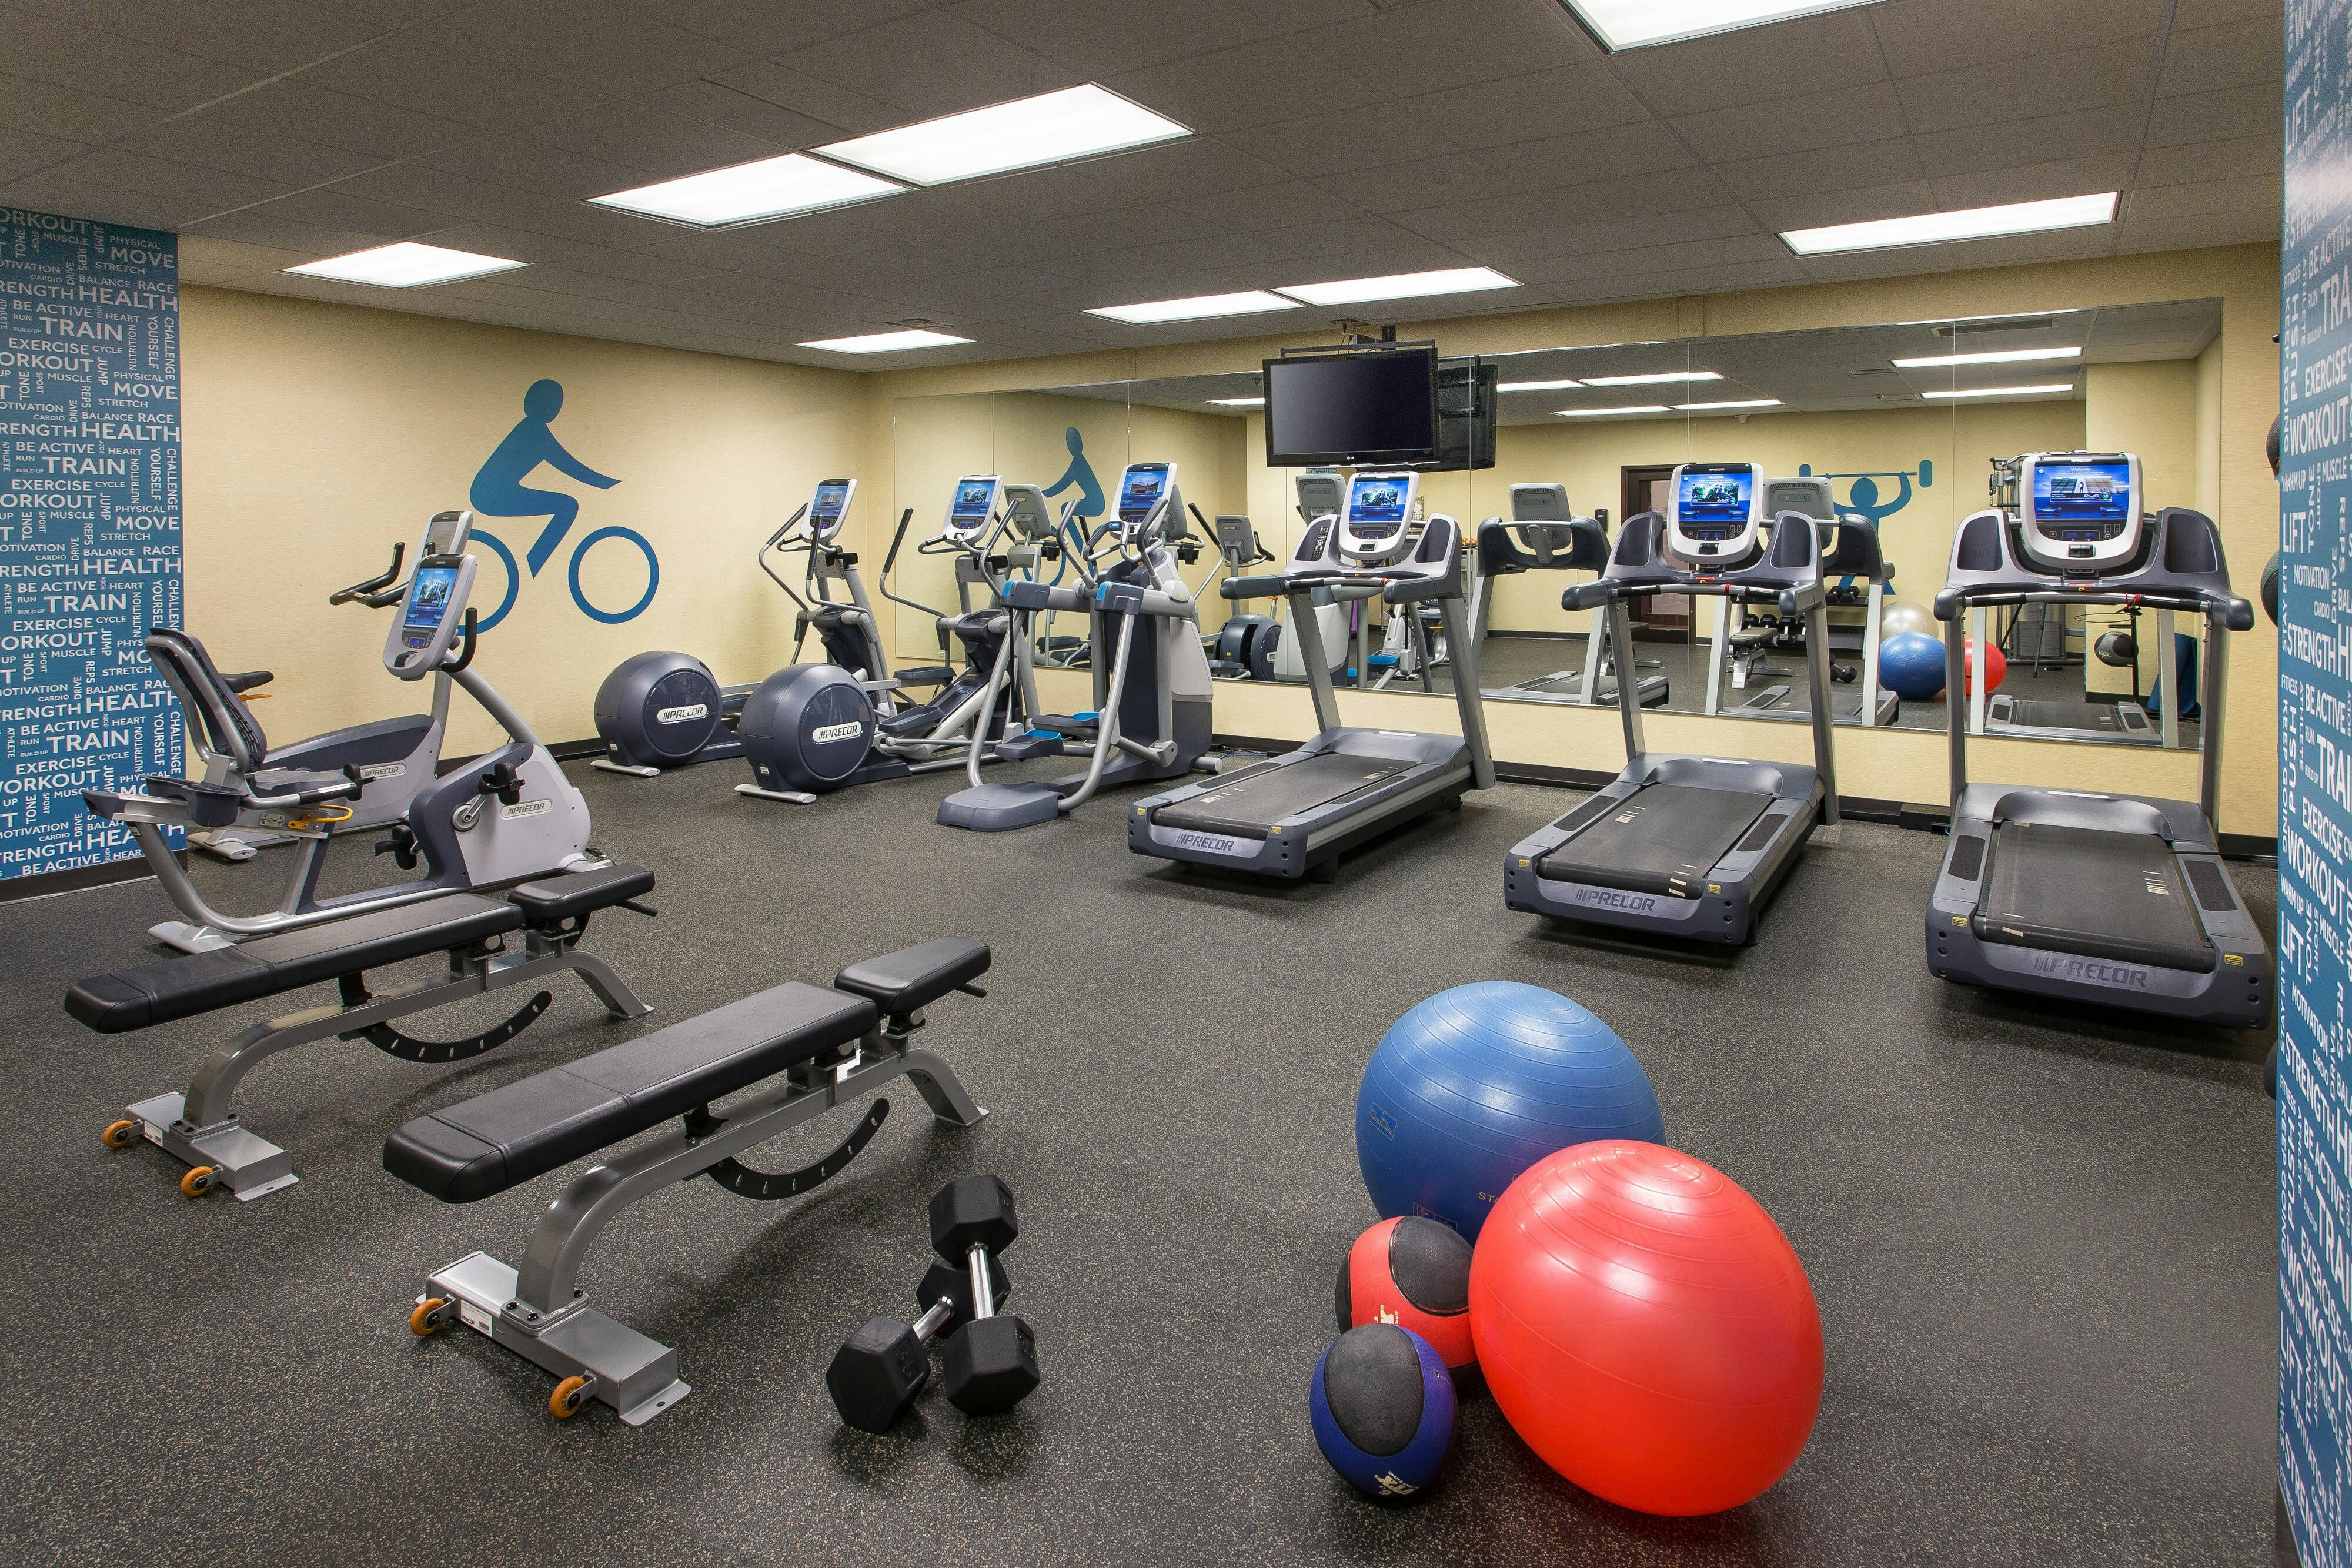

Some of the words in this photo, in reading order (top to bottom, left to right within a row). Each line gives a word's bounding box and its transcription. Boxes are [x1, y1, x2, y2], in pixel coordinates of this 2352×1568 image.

[111, 246, 175, 268] MOVE
[95, 262, 145, 275] STRETCH
[79, 282, 178, 312] HEALTH
[138, 280, 174, 293] RACE
[14, 300, 32, 311] BE
[36, 303, 92, 317] ACTIVE
[106, 313, 140, 322] HEART
[39, 315, 122, 341] TRAIN
[9, 338, 89, 355] EXERCISE
[128, 325, 136, 370] NUTRITION
[148, 316, 159, 369] YOURSELF
[165, 318, 175, 380] CHALLENGE
[48, 373, 92, 382] MUSCLE
[98, 357, 108, 385] JUMP
[114, 372, 164, 382] PHYSICAL
[2305, 349, 2347, 399] EXERCISE
[19, 372, 29, 400] TONE
[35, 372, 44, 394] SPORT
[114, 382, 177, 399] MOVE
[81, 386, 91, 408] REPS
[98, 398, 148, 407] STRETCH
[82, 412, 133, 421] BALANCE
[138, 413, 174, 423] RACE
[2290, 396, 2349, 456] WORKOUT
[82, 422, 180, 442] HEALTH
[16, 442, 35, 452] BE
[39, 443, 95, 453] ACTIVE
[42, 456, 125, 475] TRAIN
[151, 448, 161, 500] YOURSELF
[2322, 457, 2347, 482] MUSCLE
[12, 479, 92, 490] EXERCISE
[131, 459, 139, 503] NUTRITION
[166, 448, 178, 510] CHALLENGE
[2282, 472, 2297, 492] WARM
[2298, 470, 2306, 490] UP
[50, 511, 95, 520] MUSCLE
[100, 493, 111, 520] JUMP
[22, 512, 32, 540] TONE
[84, 523, 93, 545] REPS
[116, 516, 179, 530] MOVE
[2283, 512, 2306, 553] LIFT
[71, 538, 79, 560] DRIVE
[143, 546, 179, 555] RACE
[83, 558, 181, 575] HEALTH
[2294, 564, 2329, 590] MOTIVATION
[18, 583, 36, 593] BE
[41, 581, 96, 591] ACTIVE
[44, 594, 126, 613] TRAIN
[133, 592, 141, 637] NUTRITION
[2314, 601, 2330, 619] CARDIO
[13, 618, 93, 631] EXERCISE
[51, 648, 96, 657] MUSCLE
[101, 628, 111, 656] JUMP
[2287, 623, 2336, 675] STRENGTH
[2, 656, 16, 664] UP
[23, 653, 34, 682] TONE
[102, 666, 152, 676] STRETCH
[86, 661, 95, 683] REPS
[86, 683, 138, 694] BALANCE
[2281, 674, 2298, 696] FITNESS
[670, 706, 703, 720] PRECOR
[2306, 684, 2315, 715] BE
[2316, 690, 2346, 734] ACTIVE
[21, 725, 40, 735] BE
[44, 718, 99, 733] ACTIVE
[112, 717, 146, 726] HEART
[826, 724, 858, 739] PRECOR
[6, 727, 15, 758] ATHLETE
[46, 729, 128, 753] TRAIN
[134, 727, 143, 772] NUTRITION
[154, 713, 164, 765] YOURSELF
[171, 711, 181, 774] CHALLENGE
[16, 756, 96, 775] EXERCISE
[99, 751, 129, 761] CYCLE
[371, 766, 399, 776] PRECOR
[3, 798, 18, 807] UP
[26, 795, 36, 824] TONE
[513, 802, 545, 814] PRECOR
[74, 814, 82, 837] DRIVE
[2302, 796, 2343, 865] EXERCISE
[39, 833, 69, 841] CARDIO
[1185, 835, 1234, 851] PRECOR
[0, 840, 81, 863] RENGTH
[22, 864, 41, 875] BE
[45, 854, 101, 871] ACTIVE
[2287, 825, 2345, 925] WORKOUT
[1588, 890, 1656, 912] PRECOR
[2280, 874, 2296, 910] WARM
[2281, 911, 2304, 975] LIFT
[2319, 914, 2344, 964] MUSCLE
[2050, 958, 2148, 988] PRECOR
[2291, 981, 2328, 1057] MOTIVATION
[2285, 1032, 2335, 1148] STRENGTH
